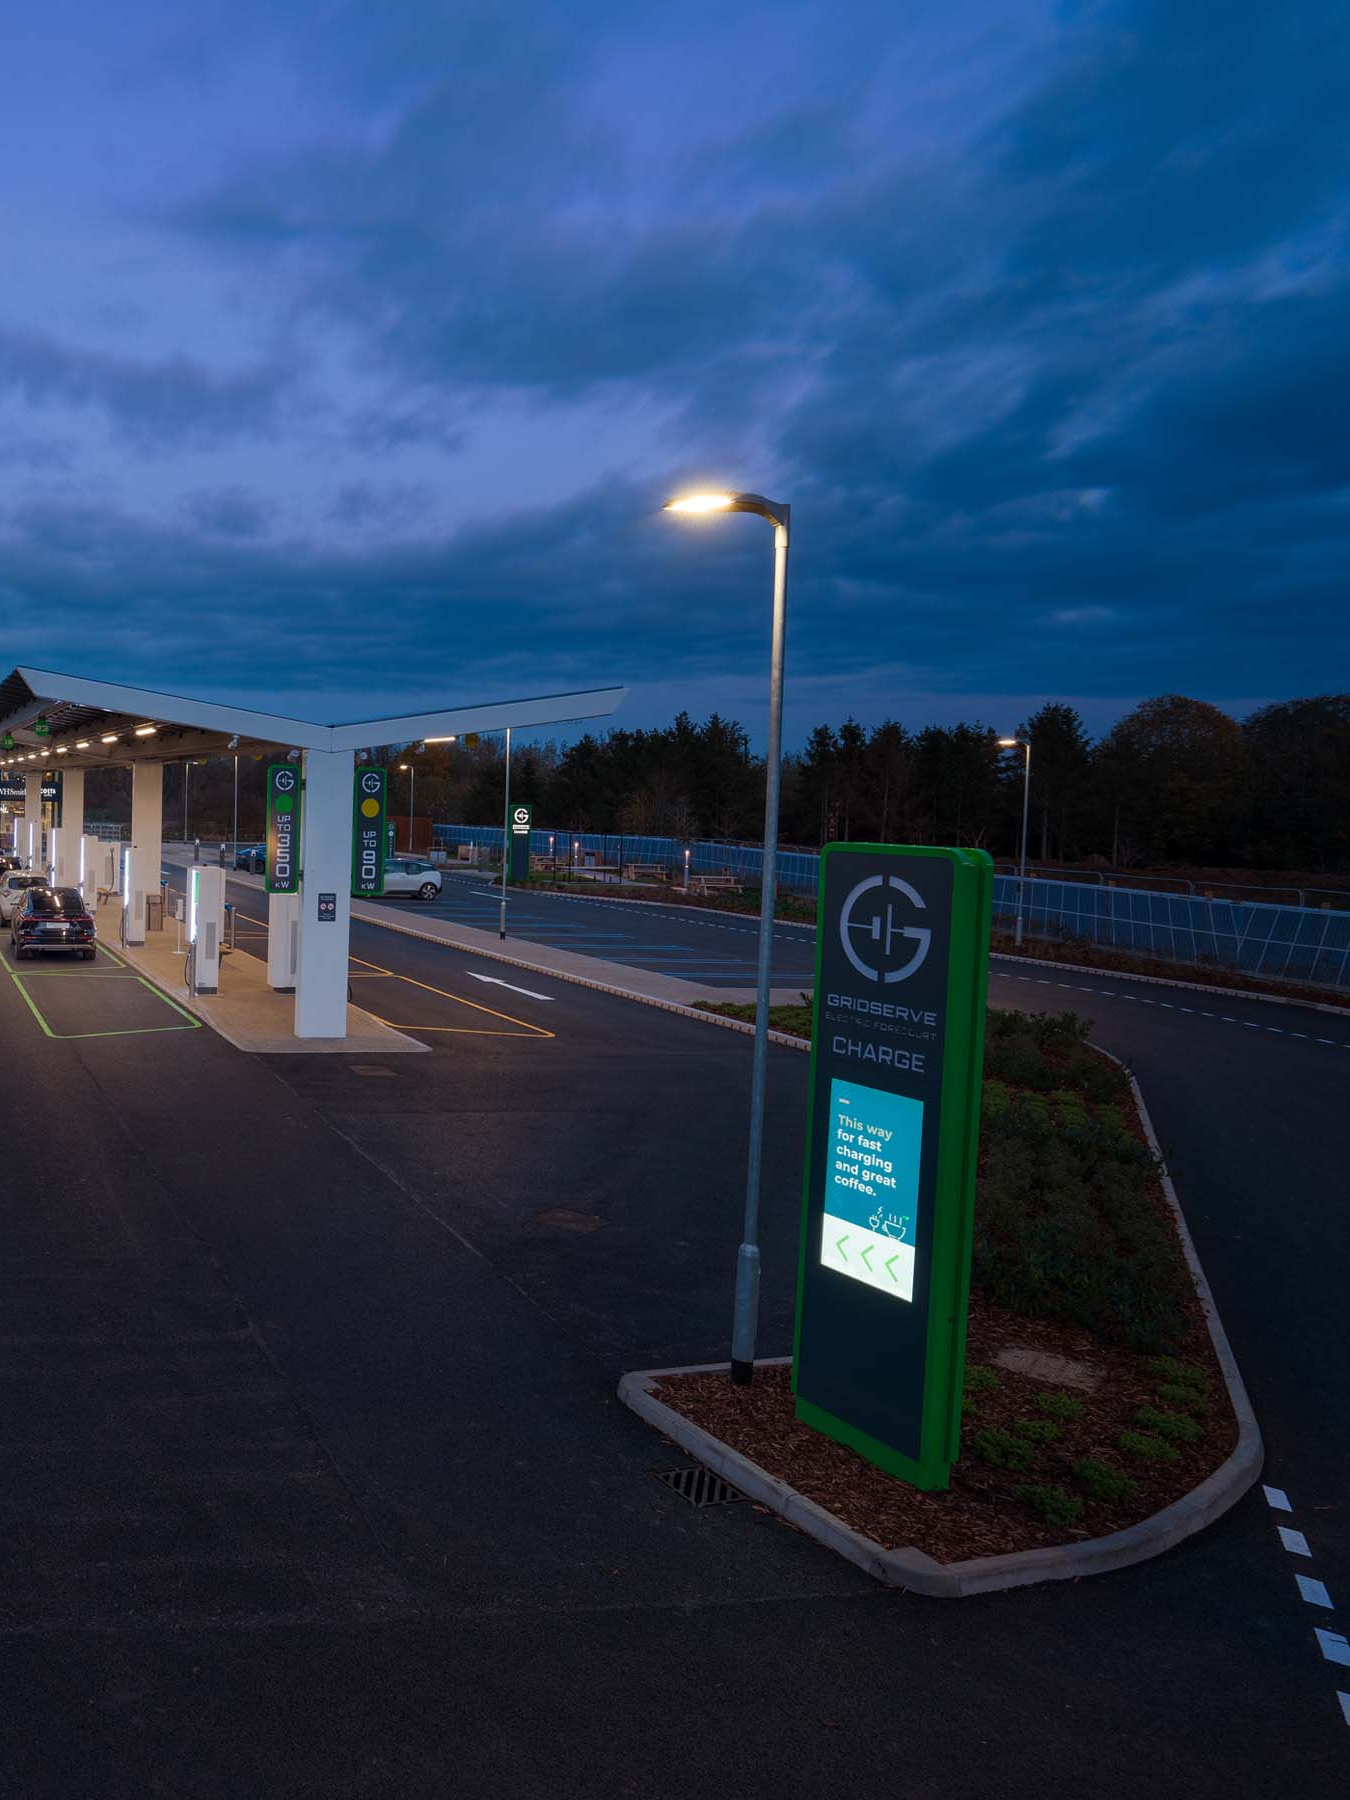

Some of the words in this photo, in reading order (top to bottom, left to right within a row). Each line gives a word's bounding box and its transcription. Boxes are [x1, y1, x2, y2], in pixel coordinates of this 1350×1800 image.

[277, 815, 291, 823] UP
[277, 824, 291, 832] TO
[362, 831, 377, 839] UP
[362, 840, 377, 848] TO
[275, 833, 291, 878] 350
[361, 850, 376, 880] 90
[826, 993, 938, 1026] GRIDSERVE
[832, 1035, 926, 1073] CHARGE
[836, 1128, 854, 1144] for
[857, 1133, 883, 1153] fast
[838, 1114, 864, 1132] This
[866, 1125, 893, 1141] way
[836, 1144, 893, 1173] charging
[834, 1174, 877, 1197] coffee.
[835, 1160, 859, 1176] and
[861, 1168, 897, 1189] great
